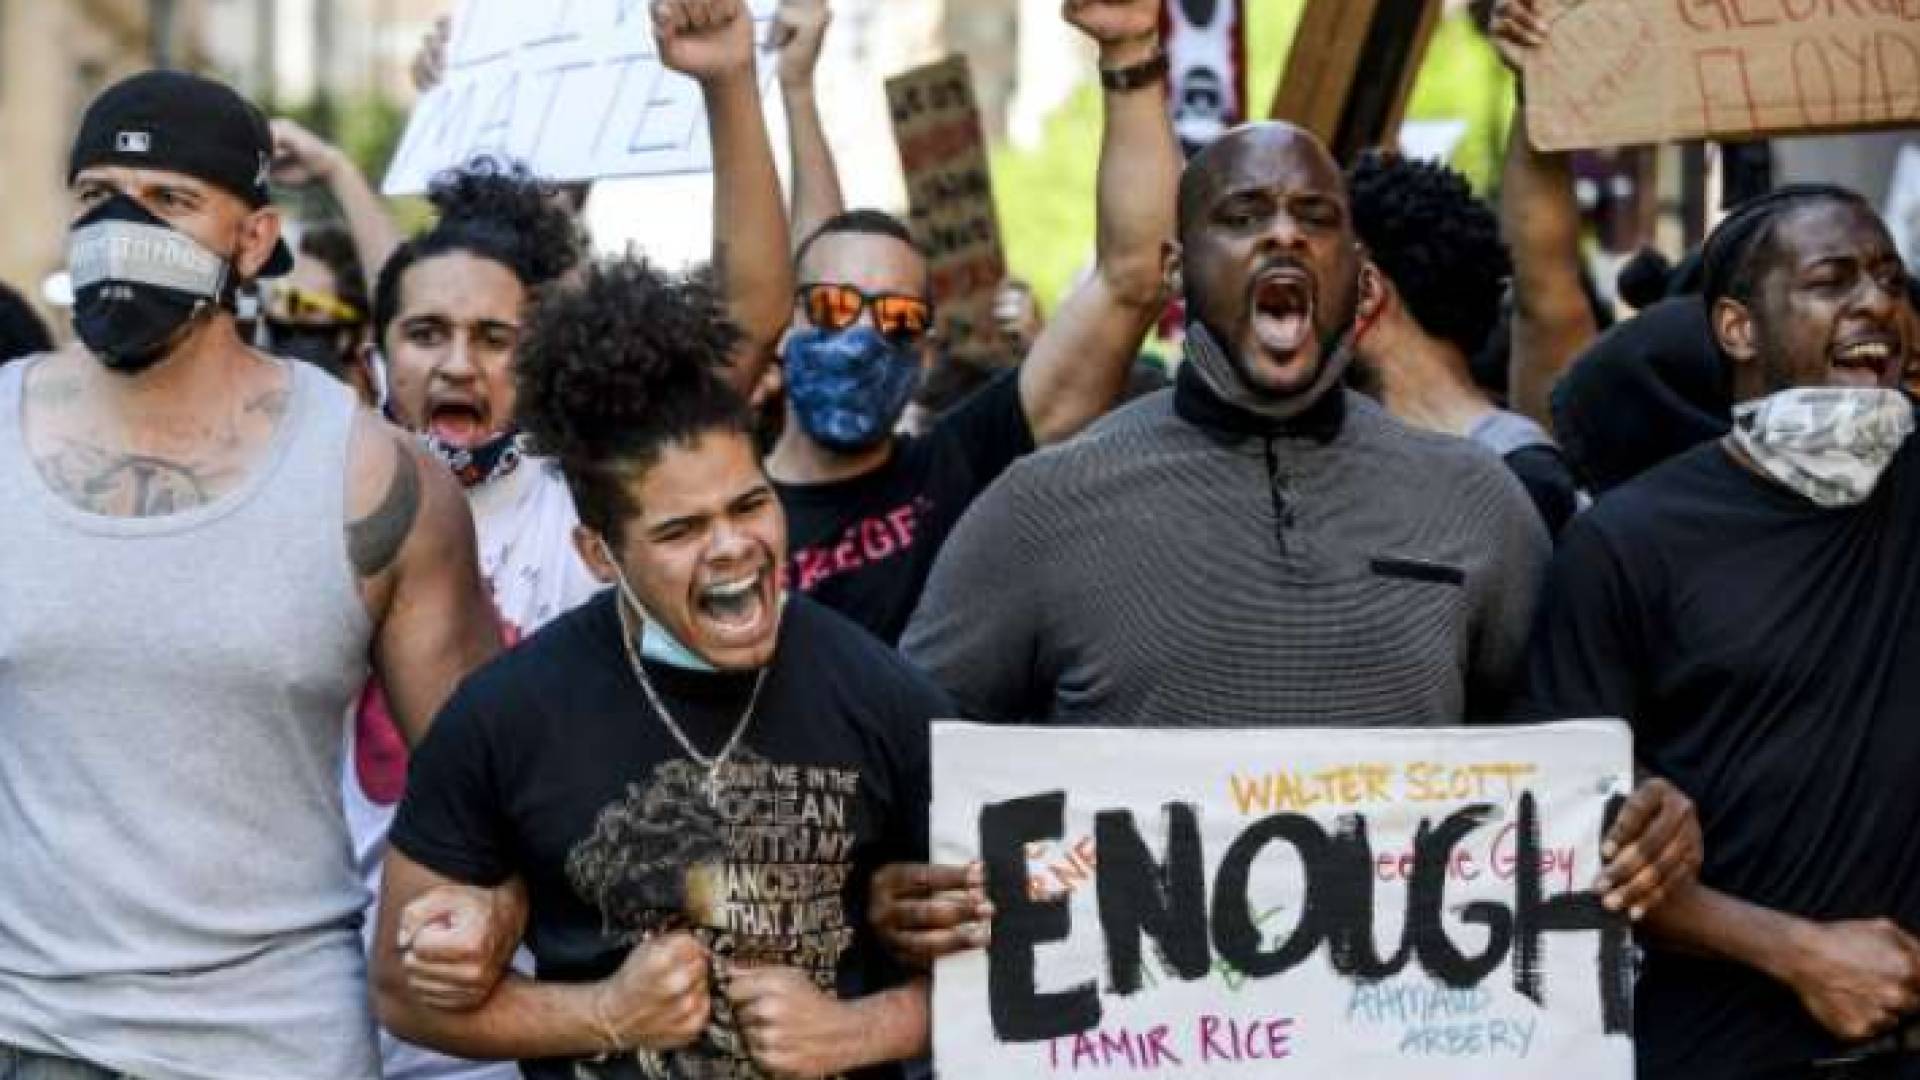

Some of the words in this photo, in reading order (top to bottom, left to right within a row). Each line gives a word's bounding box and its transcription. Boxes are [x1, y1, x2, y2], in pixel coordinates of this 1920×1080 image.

[396, 52, 698, 172] MATTE
[717, 788, 846, 827] OCEAN
[1229, 762, 1390, 813] WALTER
[1403, 760, 1537, 798] SCOTT
[979, 788, 1635, 1040] ENOUGH
[1199, 1014, 1294, 1063] RICE
[1399, 1016, 1538, 1060] ARBERY
